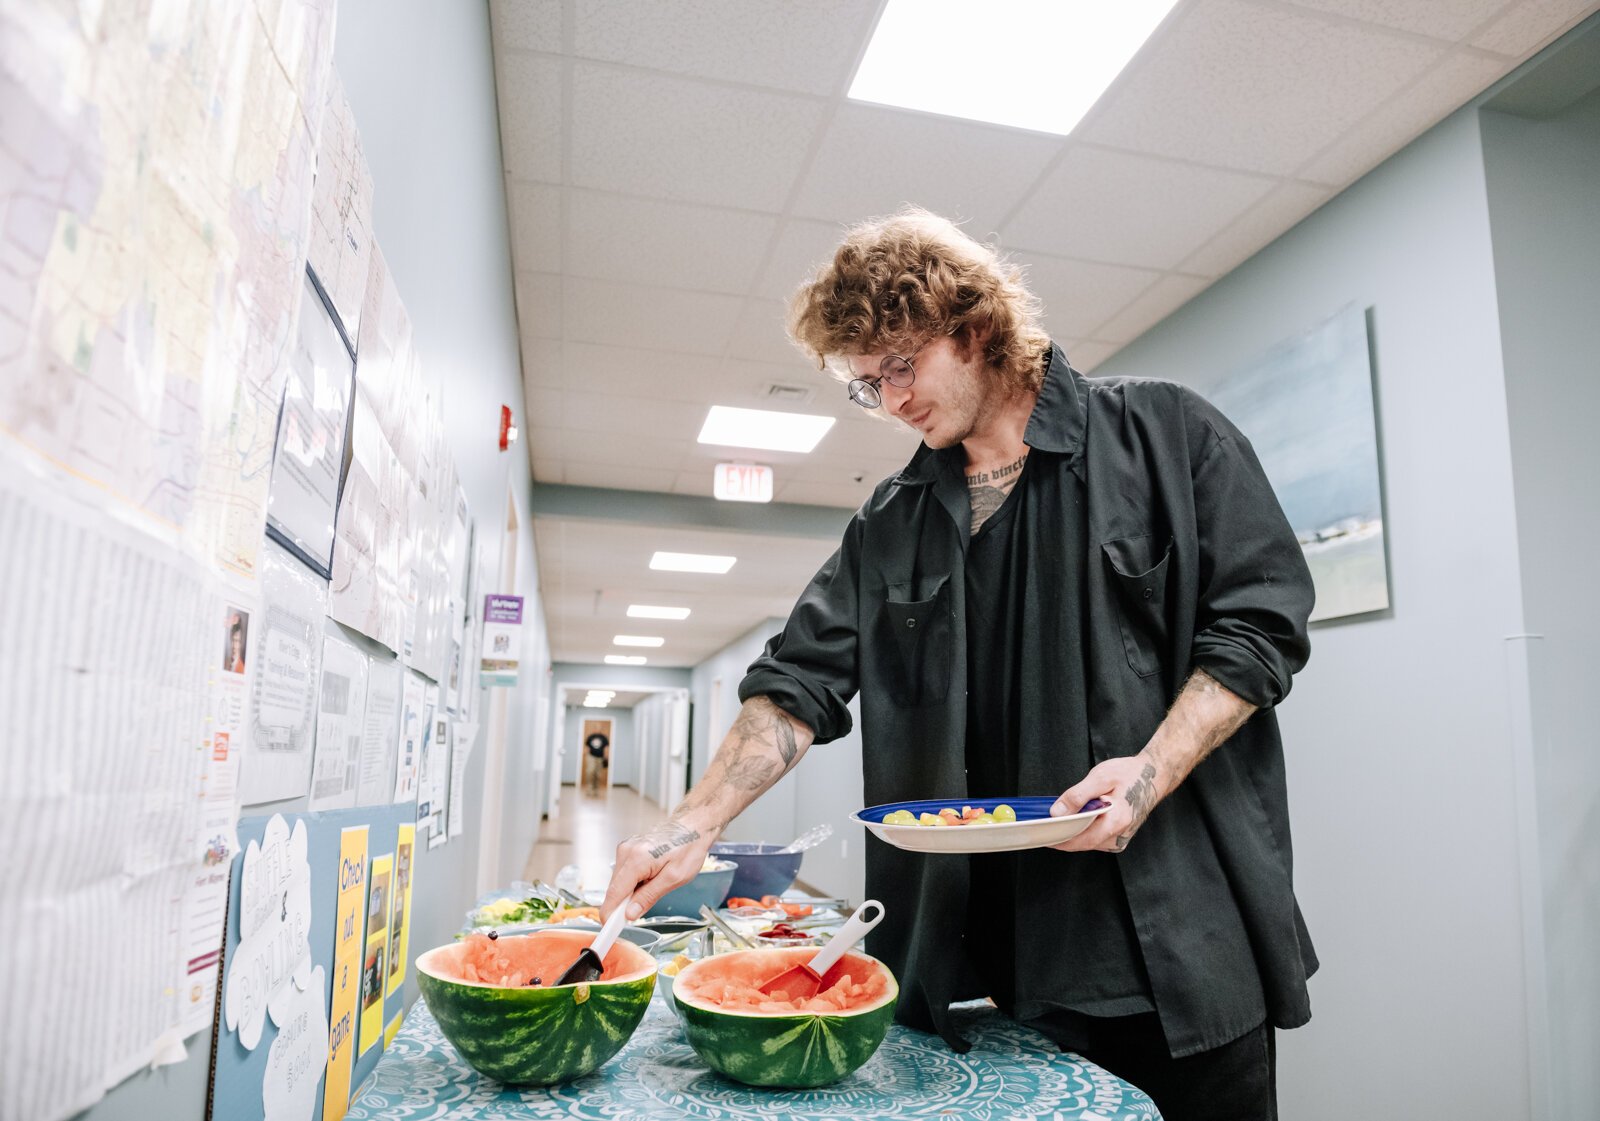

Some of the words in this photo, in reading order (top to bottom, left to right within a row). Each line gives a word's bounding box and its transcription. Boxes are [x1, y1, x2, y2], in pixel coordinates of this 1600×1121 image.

[726, 466, 765, 496] EXIT
[342, 853, 364, 891] Check
[343, 907, 355, 942] out
[341, 965, 348, 989] a
[331, 1011, 350, 1061] game
